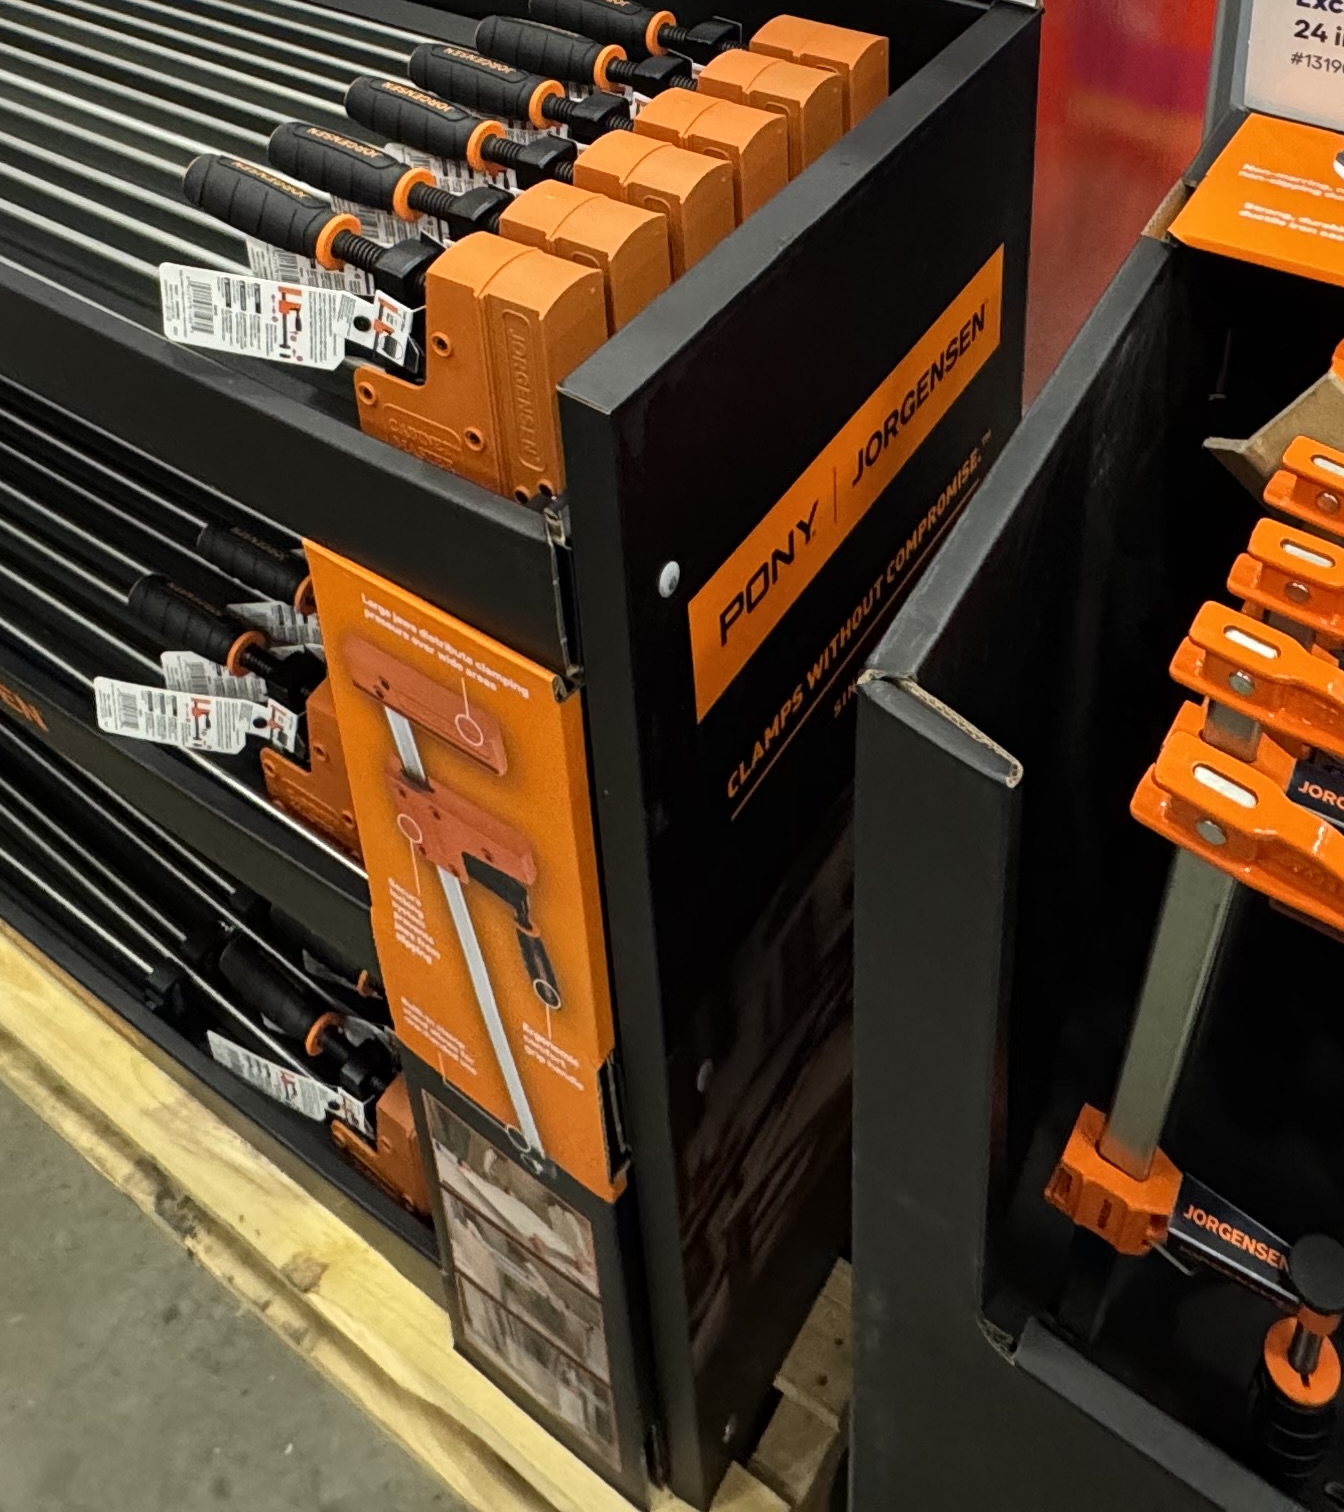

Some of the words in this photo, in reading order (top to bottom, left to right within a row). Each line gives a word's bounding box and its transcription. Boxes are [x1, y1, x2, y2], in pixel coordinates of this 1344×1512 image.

[1294, 18, 1328, 43] 24
[720, 498, 819, 648] PONY
[851, 302, 986, 489] JORGENSEN
[726, 687, 804, 798] CLAMPS
[807, 573, 884, 691] WITHOUT
[885, 443, 982, 585] COMPROMISE.
